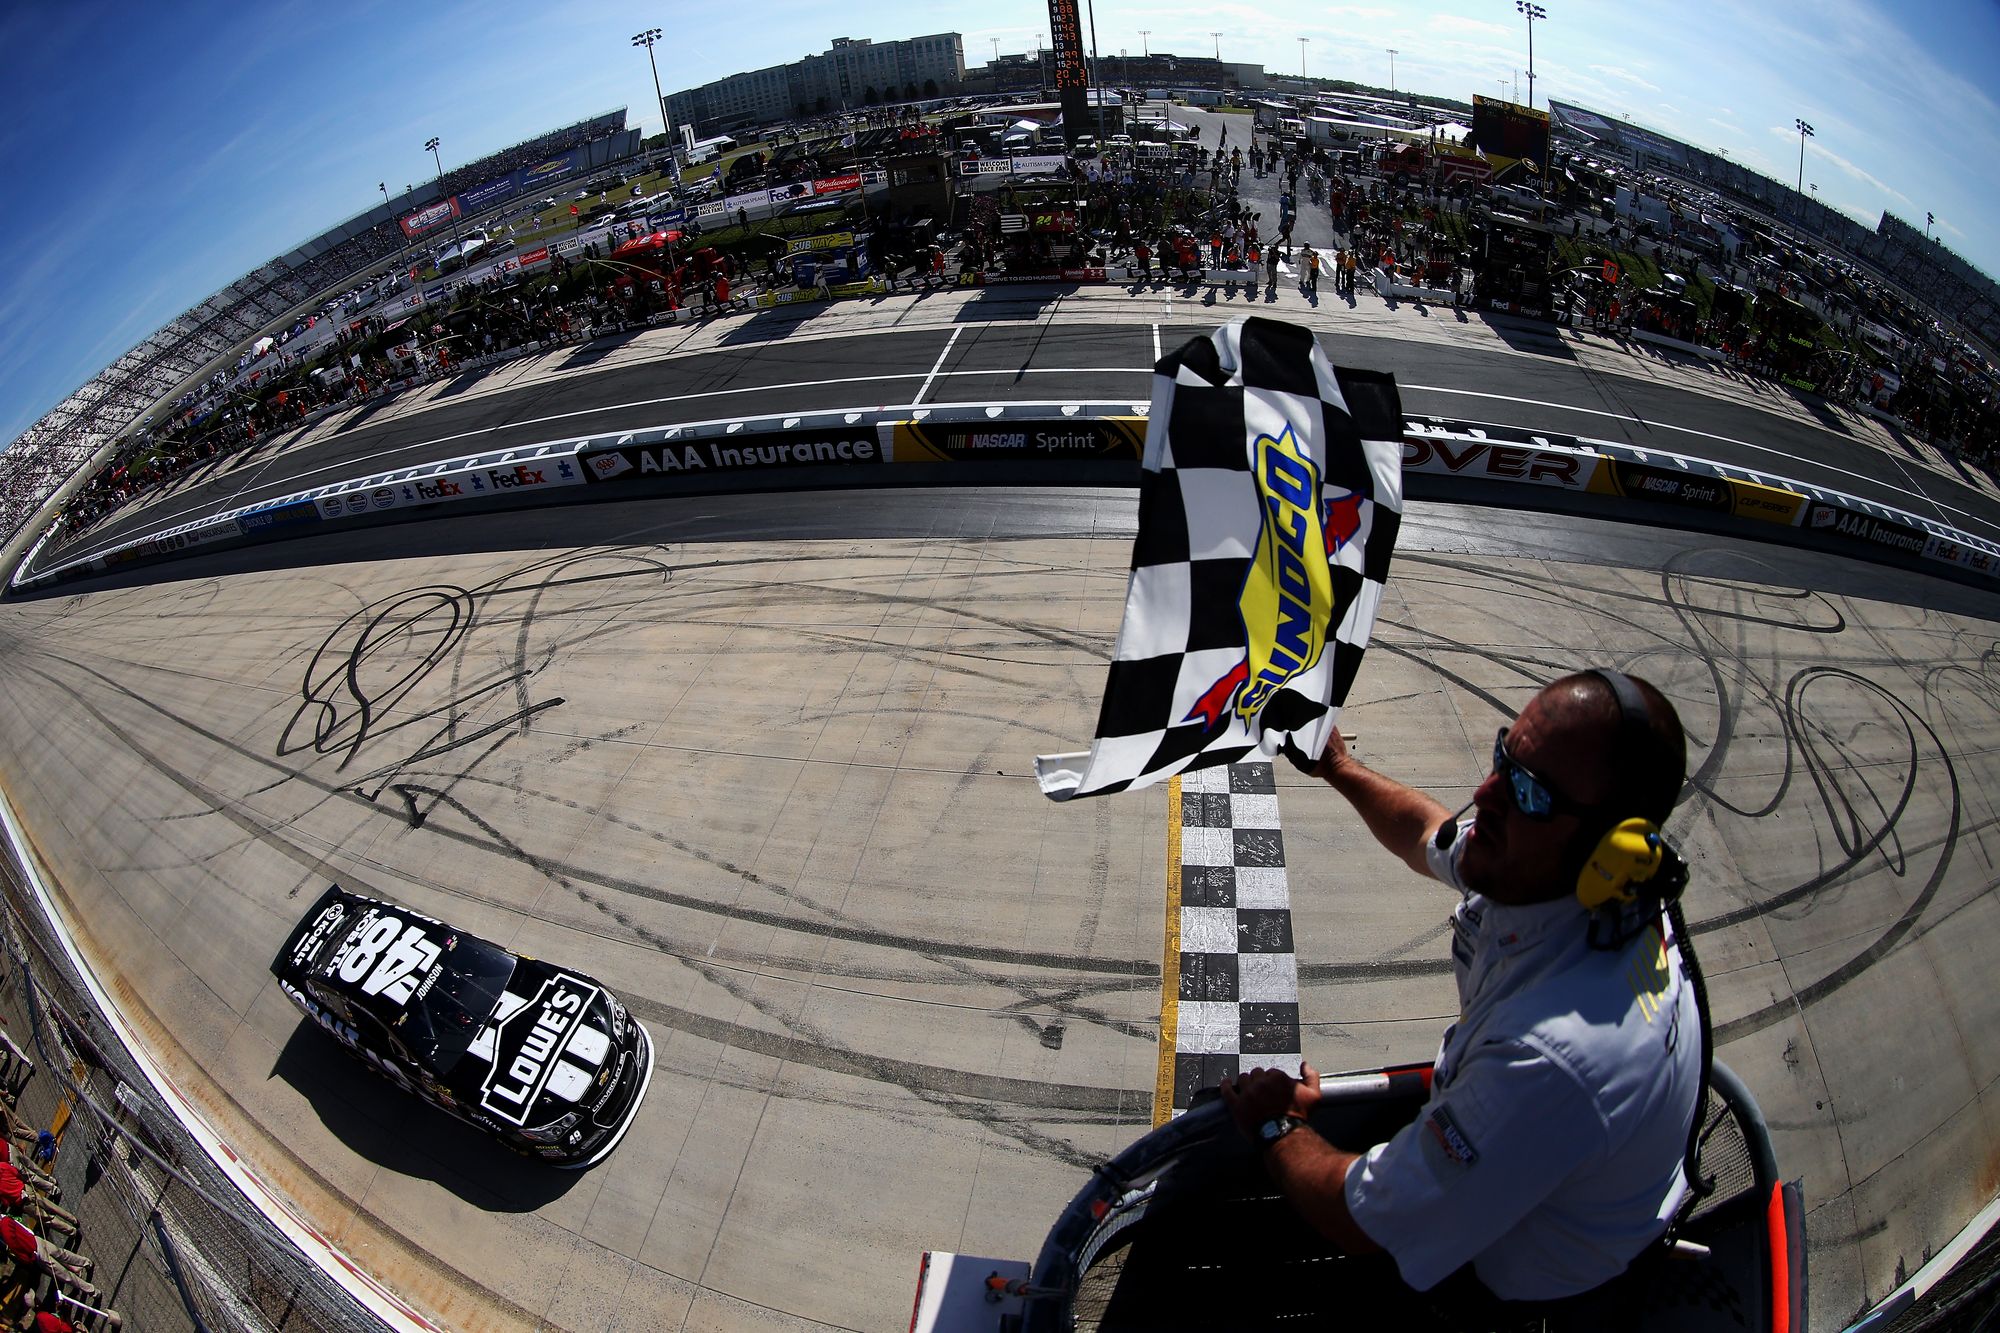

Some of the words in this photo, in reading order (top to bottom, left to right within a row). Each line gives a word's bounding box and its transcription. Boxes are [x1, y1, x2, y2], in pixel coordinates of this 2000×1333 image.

[1052, 6, 1058, 14] 9
[1059, 4, 1073, 14] 88
[1060, 14, 1074, 22] 27
[1053, 24, 1062, 32] 11
[1061, 23, 1075, 32] 42
[1062, 32, 1076, 40] 43
[1054, 42, 1064, 50] 13
[1064, 50, 1078, 59] 99
[1066, 60, 1079, 68] 24
[1056, 69, 1070, 79] 20
[1483, 97, 1503, 109] Sprint
[1520, 108, 1545, 118] Vision
[979, 160, 1009, 168] WELCOME
[815, 176, 860, 190] Budweiser
[1525, 174, 1554, 189] Sprint
[769, 183, 808, 202] Fedx
[699, 201, 724, 212] WELCOME
[612, 221, 644, 237] FedEx
[1035, 216, 1052, 226] 24
[792, 237, 835, 251] SUBWAY
[960, 272, 974, 286] 24
[776, 288, 815, 302] SUBWAY
[654, 312, 675, 321] Cessna
[972, 434, 1026, 448] NASCAR
[1036, 432, 1096, 452] Sprint
[640, 446, 706, 474] AAA
[710, 440, 874, 467] Insurance
[1402, 436, 1580, 486] OVER
[491, 466, 547, 489] FedEx
[416, 479, 464, 500] FedEx
[1642, 476, 1679, 494] NASCAR
[1681, 485, 1716, 502] Sprint
[1759, 500, 1792, 514] SERIES
[1836, 513, 1868, 540] AAA
[1870, 525, 1924, 552] Insurance
[1936, 540, 1960, 561] FedEx
[1969, 552, 1990, 571] FedEx
[1240, 444, 1313, 709] SUNOCO
[293, 920, 330, 966] KOBALT
[323, 908, 380, 978] KOBALT
[339, 916, 442, 1006] 48
[416, 962, 444, 1001] JOHNSON
[492, 988, 582, 1105] LOWE'S
[592, 1065, 620, 1112] CHEVROLET
